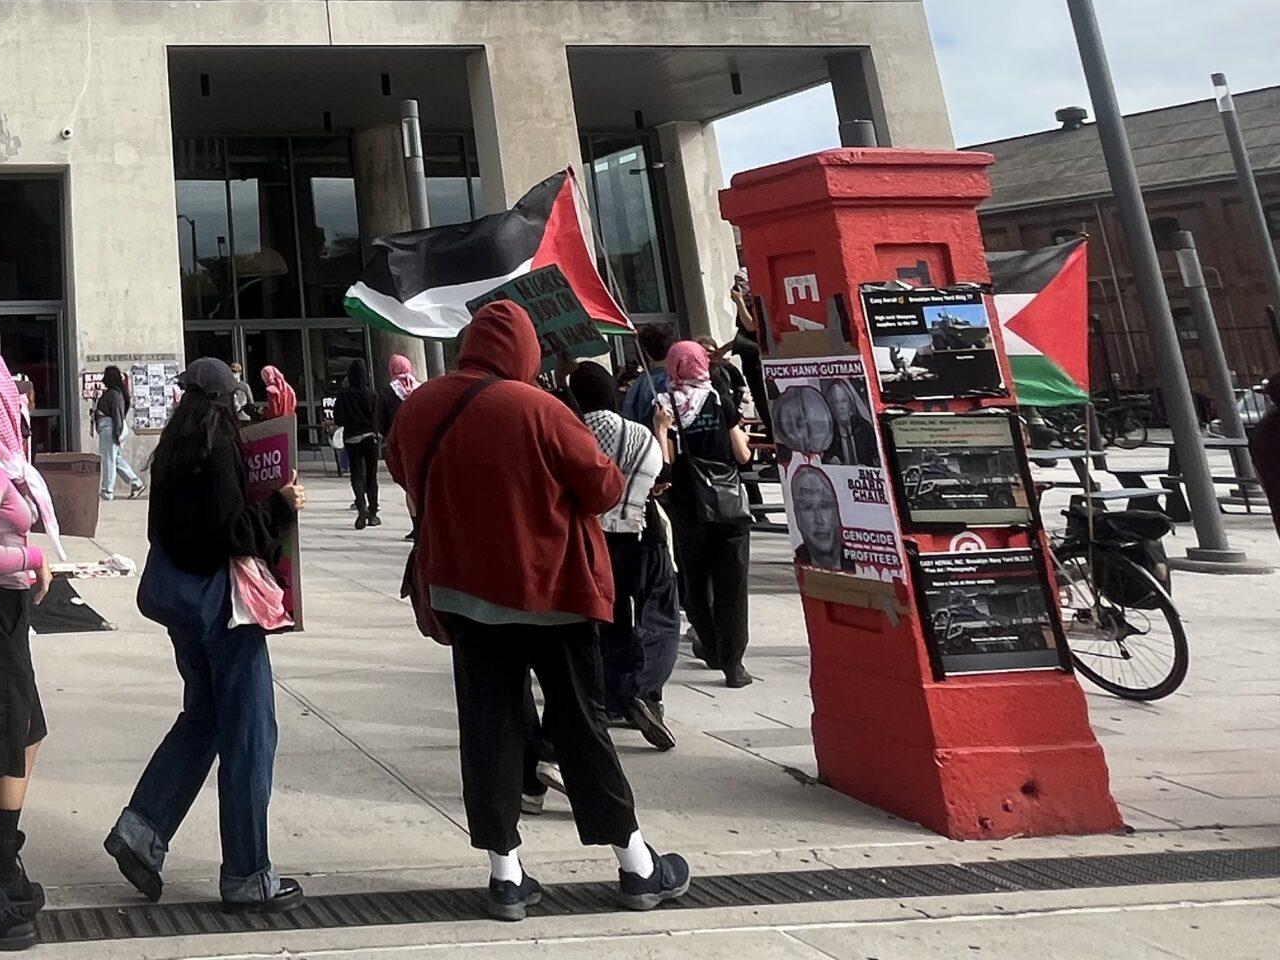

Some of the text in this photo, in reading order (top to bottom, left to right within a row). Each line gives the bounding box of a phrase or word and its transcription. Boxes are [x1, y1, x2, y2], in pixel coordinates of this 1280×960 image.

[765, 363, 861, 377] FUCK HANK GUTMAN
[263, 450, 281, 467] NO
[261, 466, 281, 481] OUR
[858, 469, 880, 480] BNY
[848, 479, 884, 491] BOARD
[852, 490, 886, 502] CHAIR
[842, 530, 894, 545] GENOCIDE
[844, 549, 899, 564] PROFITEER
